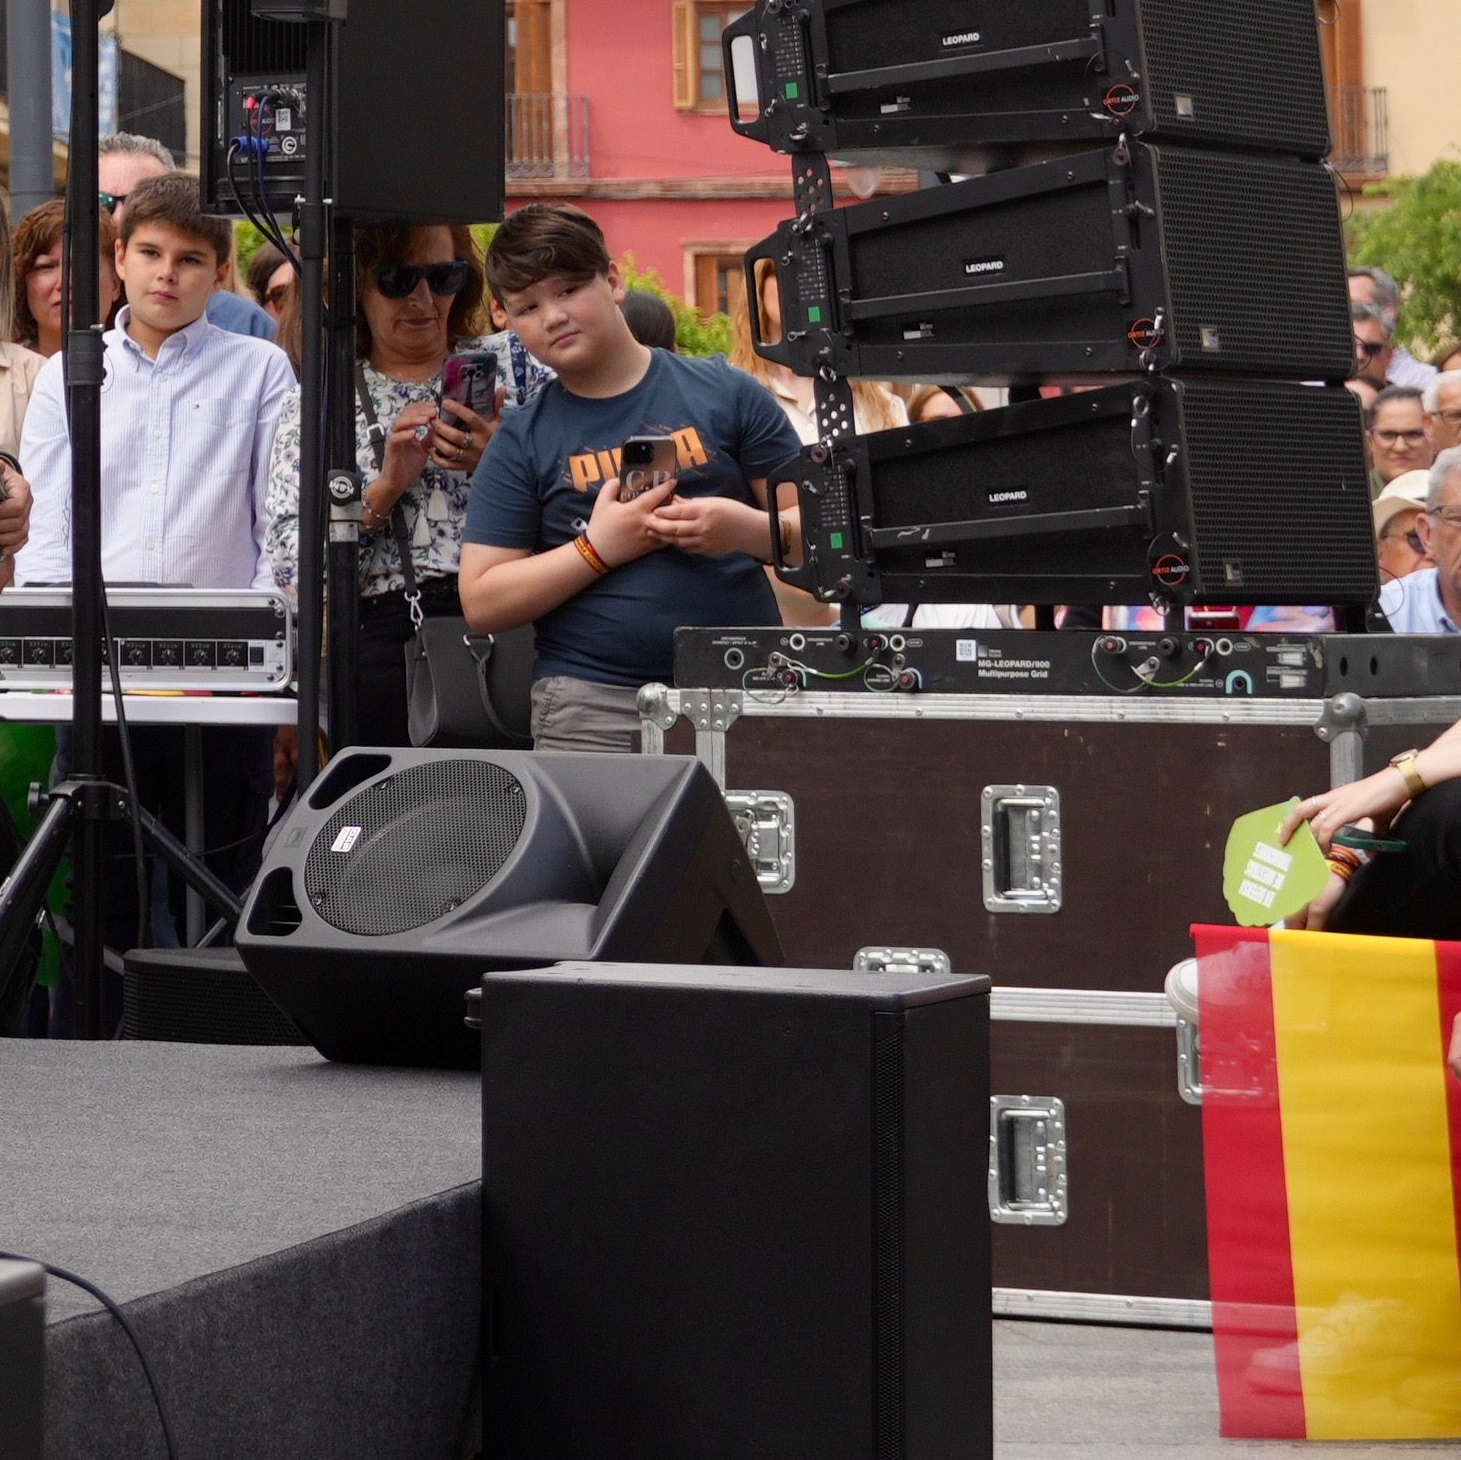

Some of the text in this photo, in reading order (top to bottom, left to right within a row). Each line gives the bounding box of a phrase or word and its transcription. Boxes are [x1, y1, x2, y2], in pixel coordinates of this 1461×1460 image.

[942, 31, 980, 46] LEOPARD
[1121, 94, 1140, 103] AUDIO
[965, 260, 1004, 274] LEOPARD
[569, 426, 709, 493] PUA
[988, 490, 1027, 503] LEOPARD
[1170, 564, 1189, 574] AUDIO
[977, 669, 1049, 679] Multipurpose Grid
